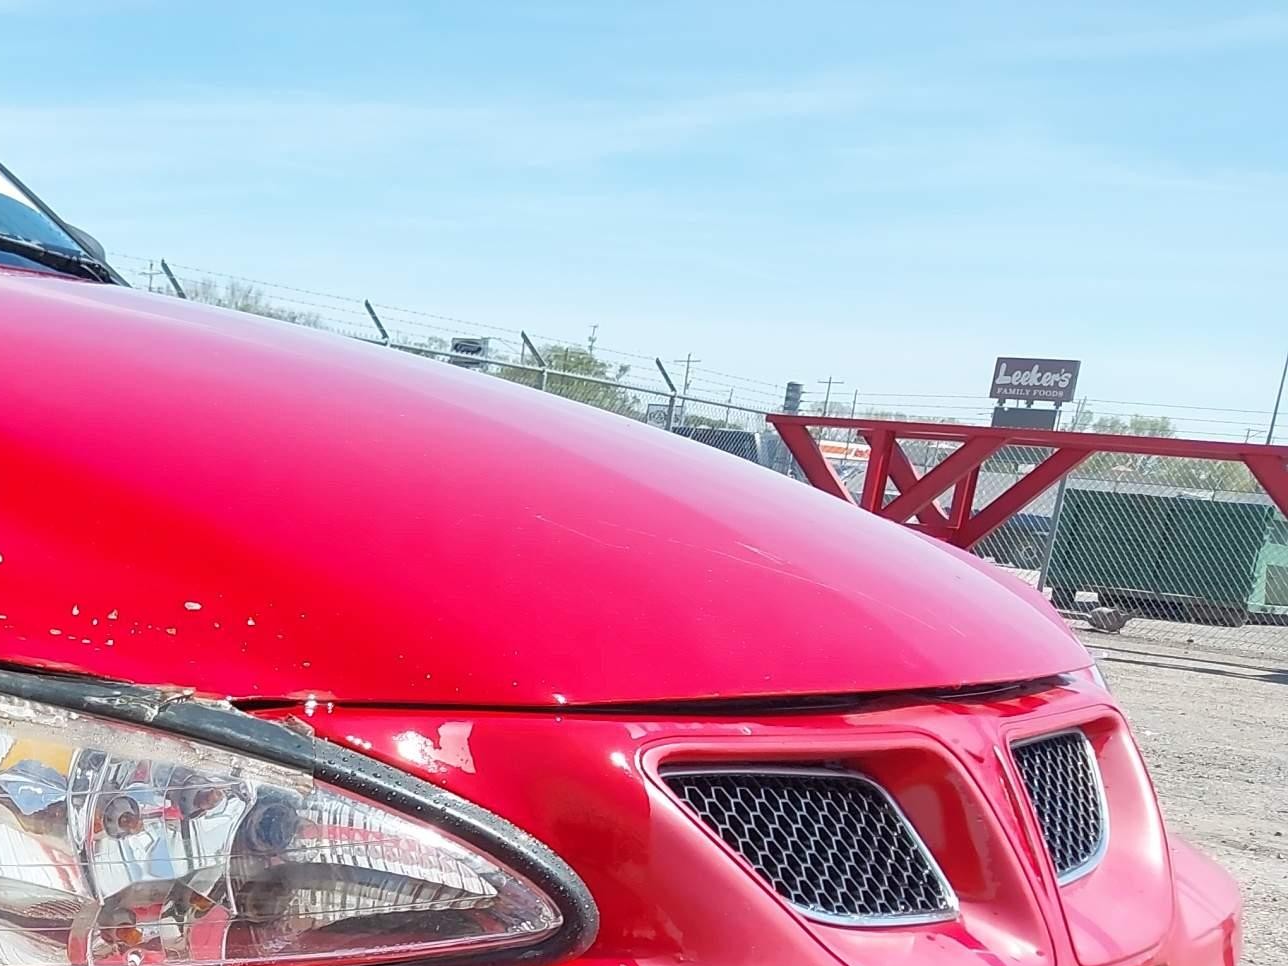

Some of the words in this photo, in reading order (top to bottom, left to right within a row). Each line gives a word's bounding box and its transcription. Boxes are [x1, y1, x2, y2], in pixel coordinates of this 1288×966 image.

[995, 362, 1072, 388] Leeker's
[995, 386, 1031, 397] FAMILY
[1032, 388, 1065, 398] FOODS
